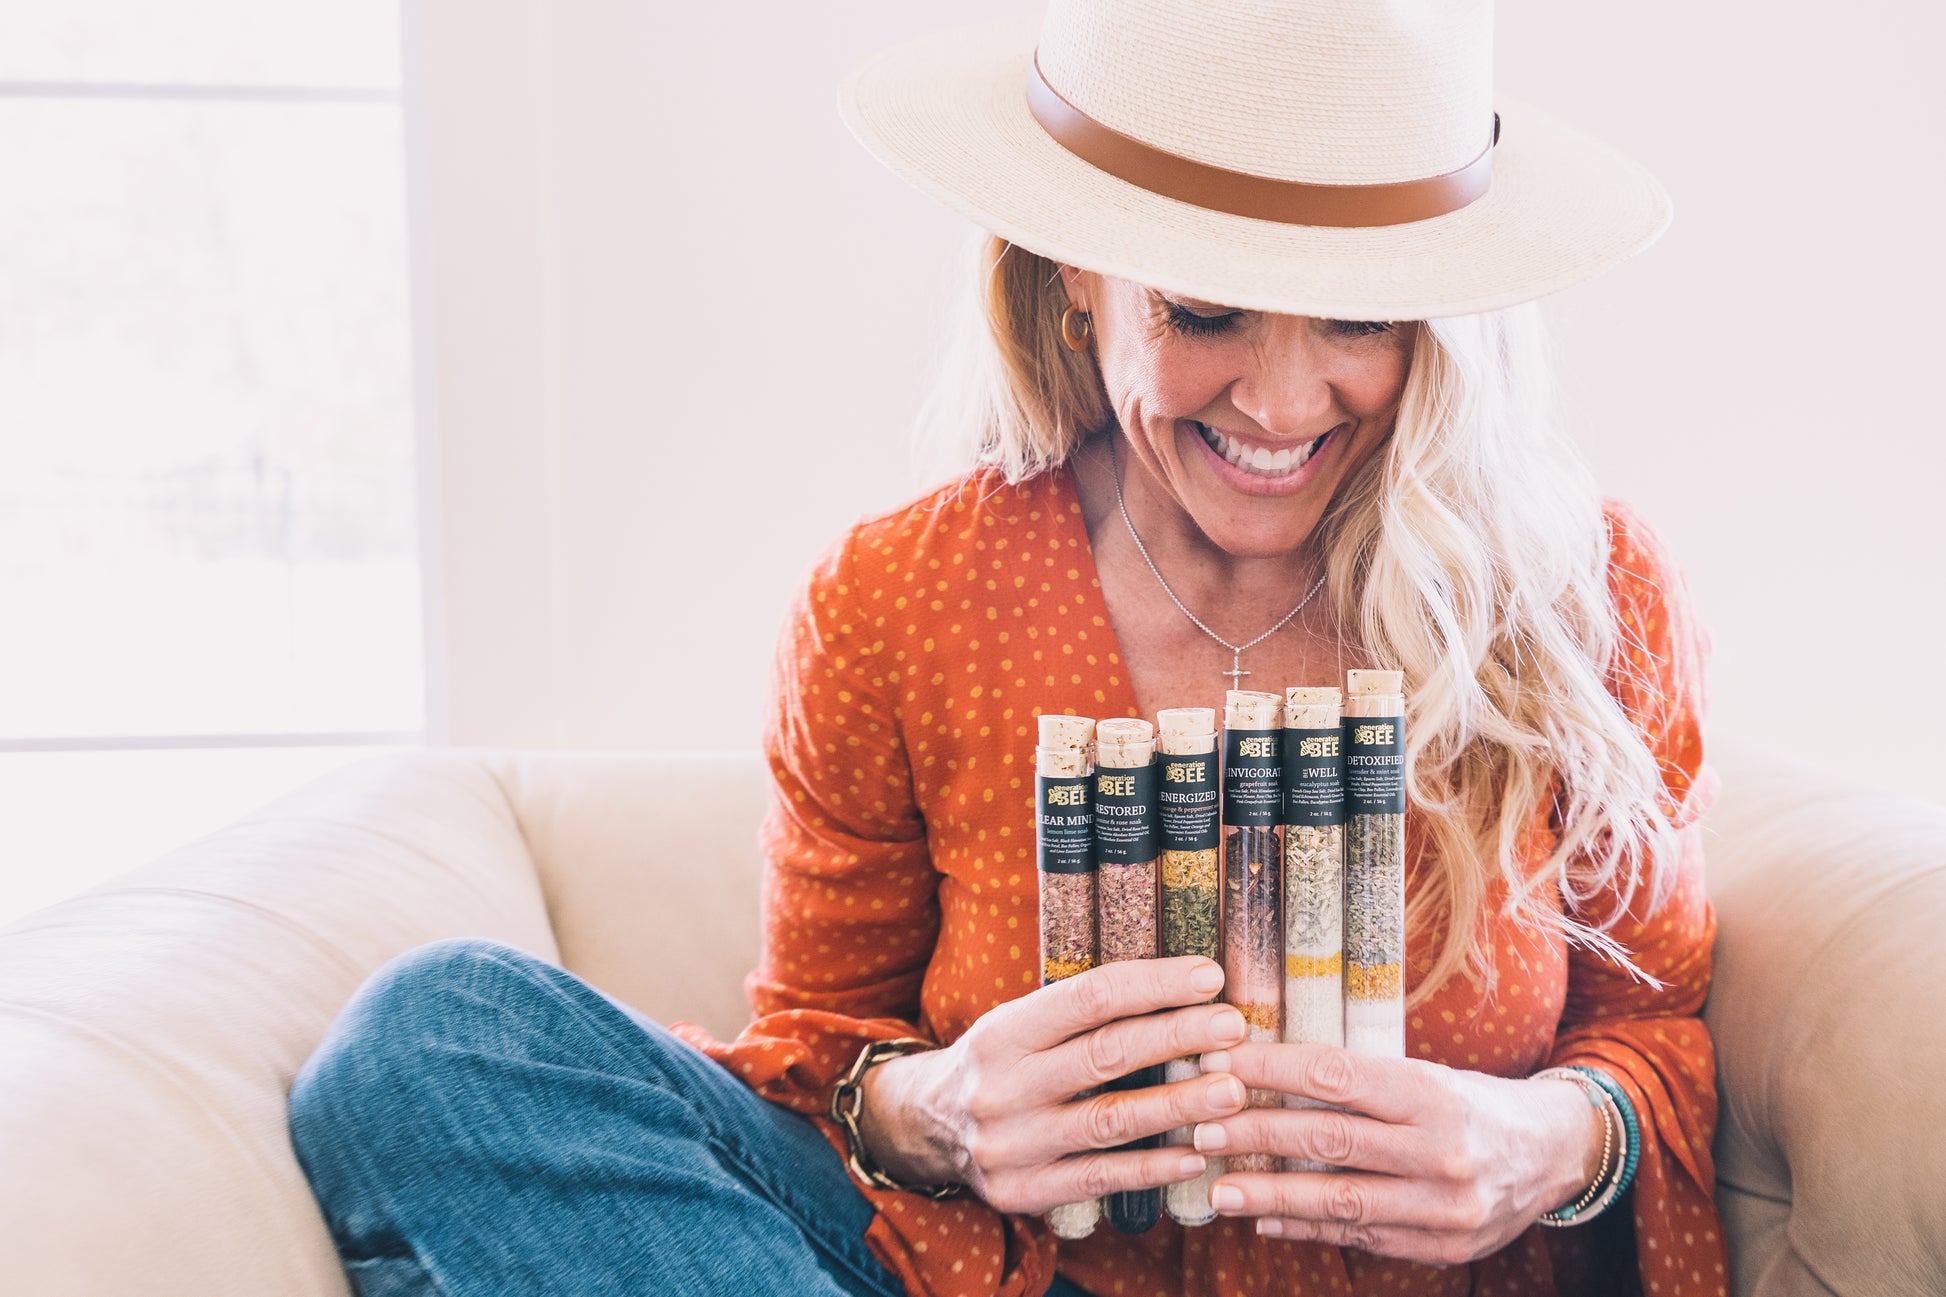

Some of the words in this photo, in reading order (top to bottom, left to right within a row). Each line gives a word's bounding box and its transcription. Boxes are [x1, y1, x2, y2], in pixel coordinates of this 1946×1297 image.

[1359, 722, 1394, 731] generation
[1363, 730, 1394, 745] BEE
[1250, 743, 1278, 757] BEE
[1310, 742, 1339, 757] BEE
[1348, 756, 1403, 766] DETOXIFIED
[1174, 767, 1205, 783] BEE
[1228, 768, 1282, 778] INVIGORAT
[1308, 767, 1338, 778] WELL
[1105, 781, 1135, 796] BEE
[1058, 790, 1088, 805] BEE
[1161, 790, 1216, 803] ENERGIZED
[1184, 804, 1214, 813] peppermint
[1040, 814, 1064, 825] LEAR
